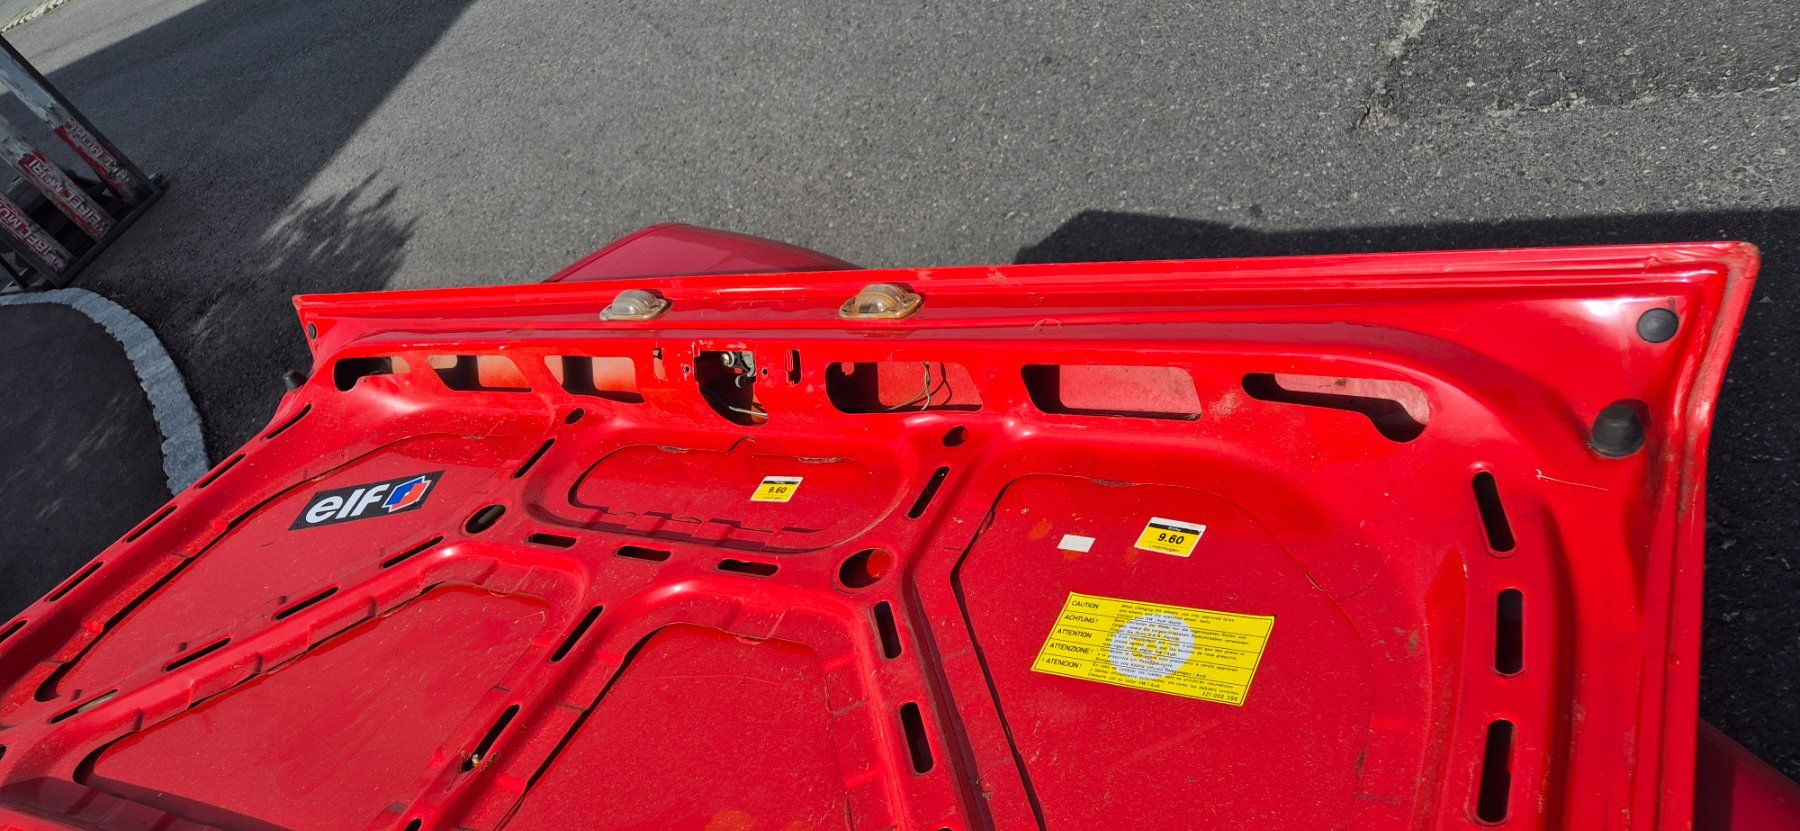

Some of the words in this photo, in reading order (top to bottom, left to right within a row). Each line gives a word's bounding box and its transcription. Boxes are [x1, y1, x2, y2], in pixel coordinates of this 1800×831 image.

[305, 484, 390, 524] elf
[1157, 532, 1185, 545] 9.60
[1058, 628, 1092, 638] ATTENTION
